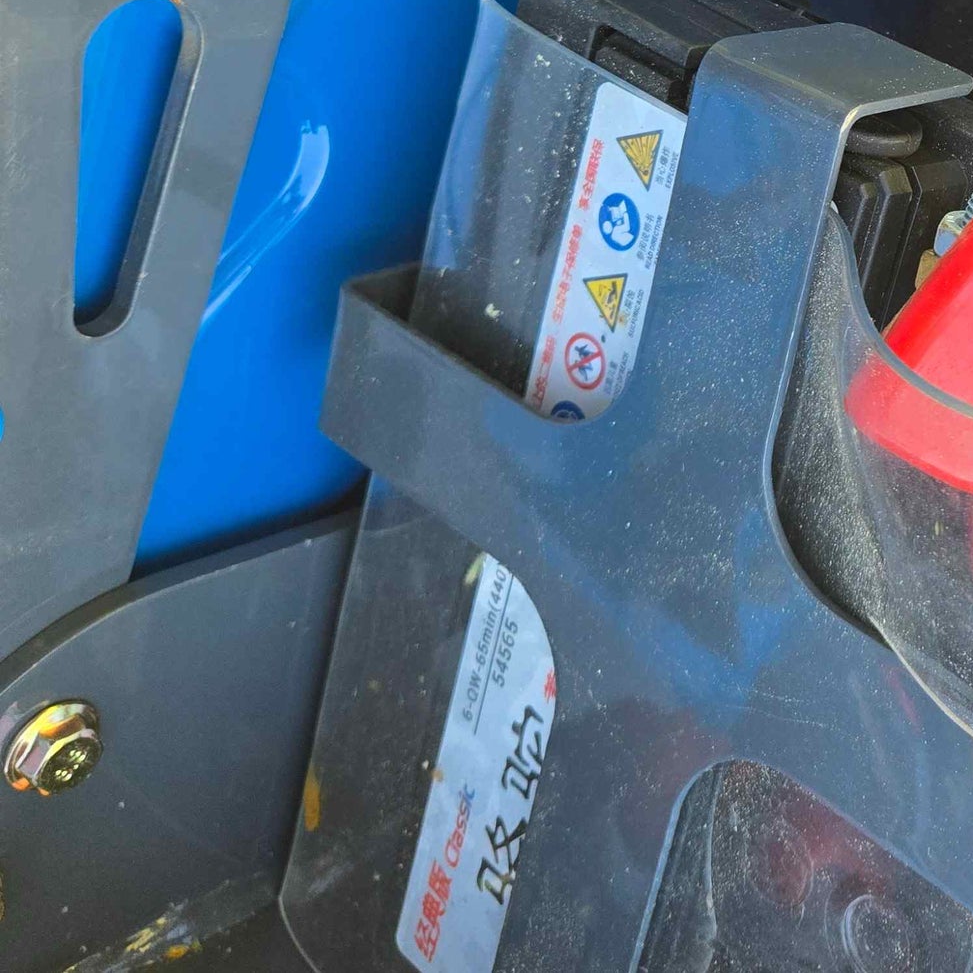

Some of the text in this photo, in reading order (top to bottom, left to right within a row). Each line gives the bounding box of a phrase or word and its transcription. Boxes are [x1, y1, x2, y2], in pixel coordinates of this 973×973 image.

[493, 619, 519, 688] 54565
[414, 784, 476, 963] 经典版 Classic
